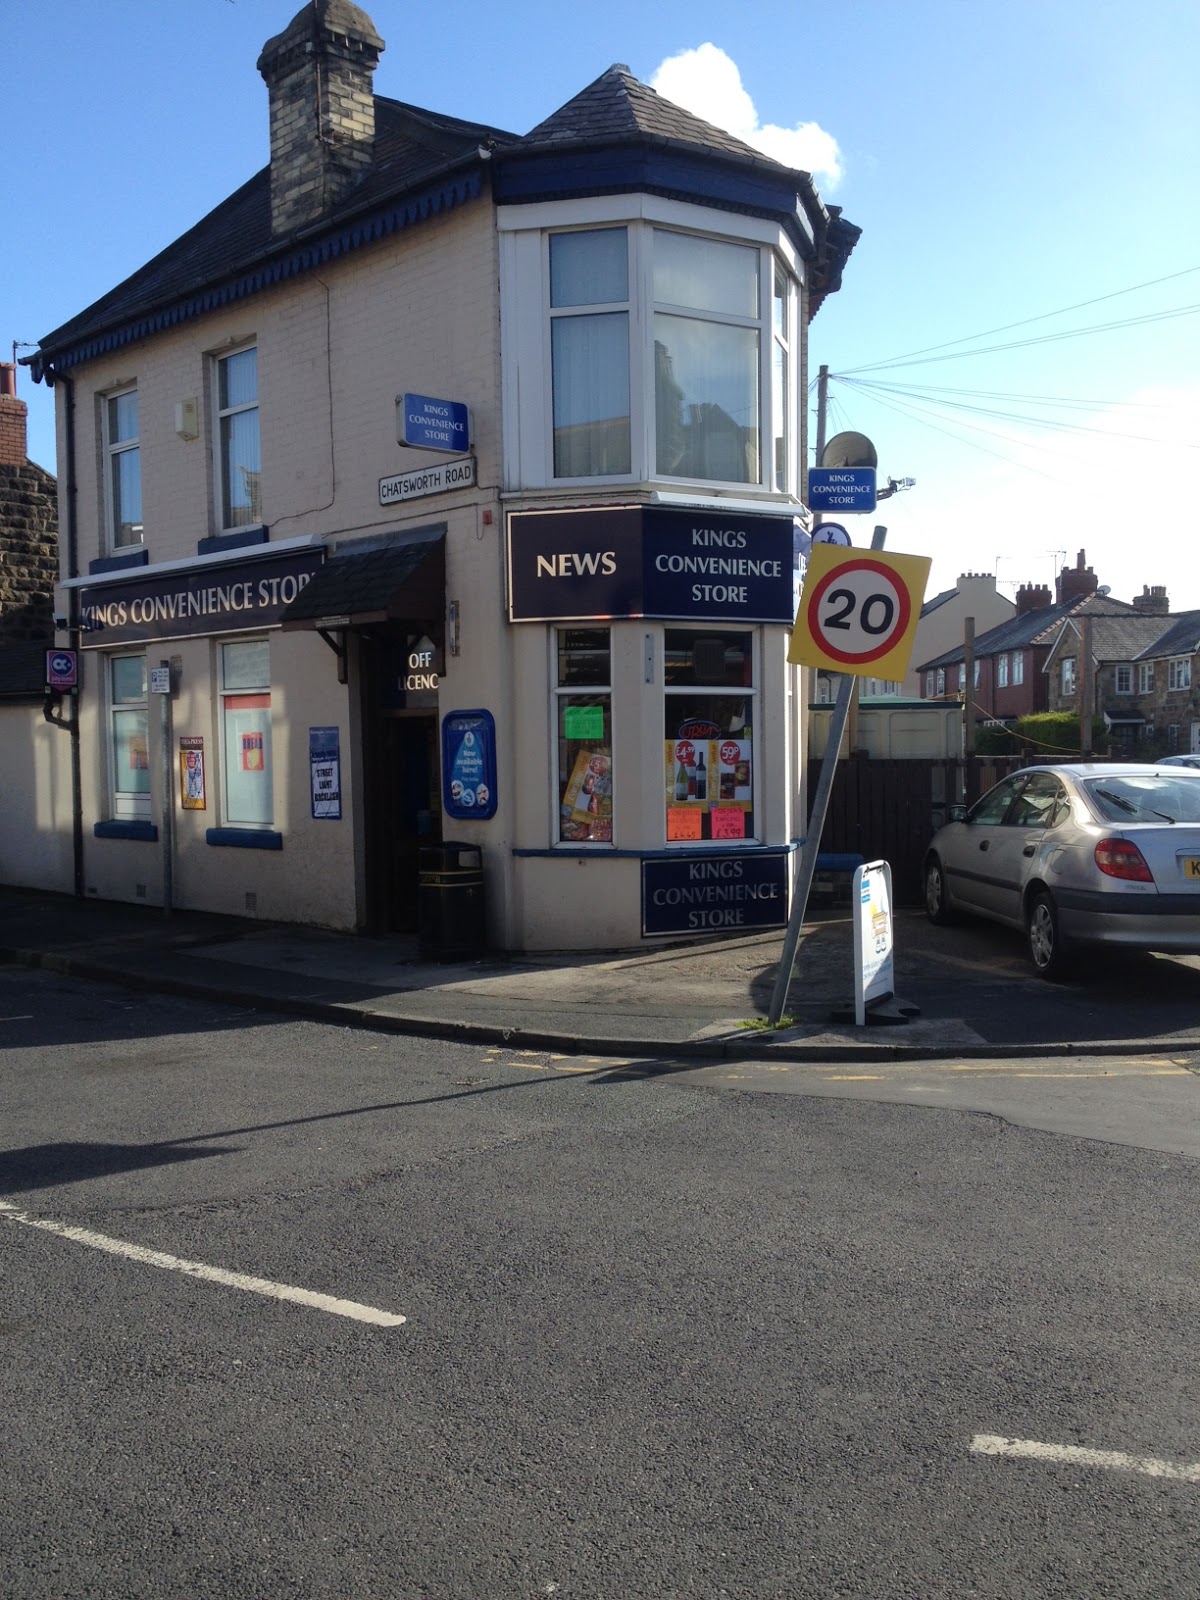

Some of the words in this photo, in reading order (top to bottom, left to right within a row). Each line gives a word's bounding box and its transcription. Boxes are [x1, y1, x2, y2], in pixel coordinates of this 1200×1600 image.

[424, 404, 449, 417] KINGS
[409, 414, 464, 432] CONVENIENCE
[424, 429, 450, 441] STORE
[381, 473, 441, 498] CHATSWORTH
[445, 465, 471, 484] ROAD
[828, 474, 855, 482] KINGS
[812, 485, 871, 493] CONVENIENCE
[828, 496, 855, 504] STORE
[692, 528, 747, 548] KINGS
[537, 551, 617, 578] NEWS
[655, 554, 782, 578] CONVENIENCE
[692, 584, 748, 603] STORE
[82, 600, 127, 628] KINGS
[130, 582, 253, 624] CONVENIENCE
[823, 588, 894, 635] 20
[408, 651, 432, 669] OFF
[398, 673, 439, 691] LICENC
[316, 768, 333, 778] STREET
[689, 861, 743, 880] KINGS
[653, 882, 778, 906] CONVENIENCE
[688, 908, 744, 928] STORE
